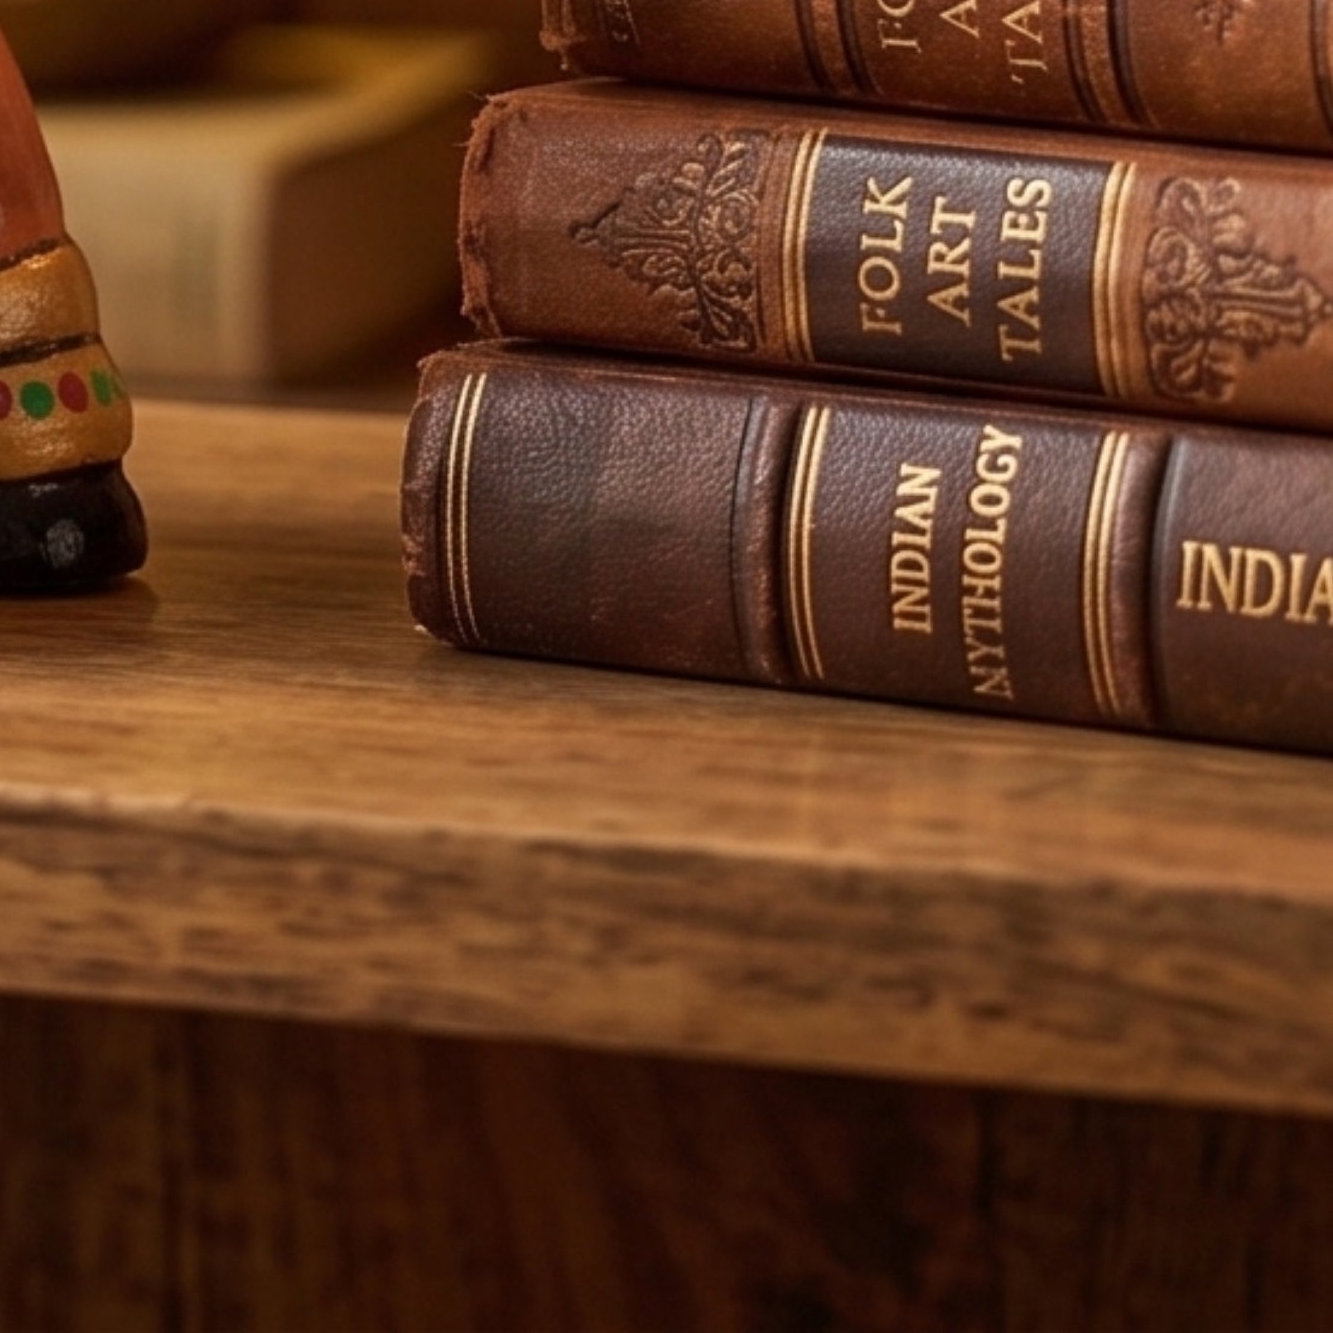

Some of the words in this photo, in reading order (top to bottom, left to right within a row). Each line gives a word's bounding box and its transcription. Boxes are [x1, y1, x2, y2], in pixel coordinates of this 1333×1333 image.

[858, 175, 914, 335] FOLK
[927, 195, 977, 327] ART
[997, 176, 1053, 362] TALES
[890, 462, 942, 635] INDIAN
